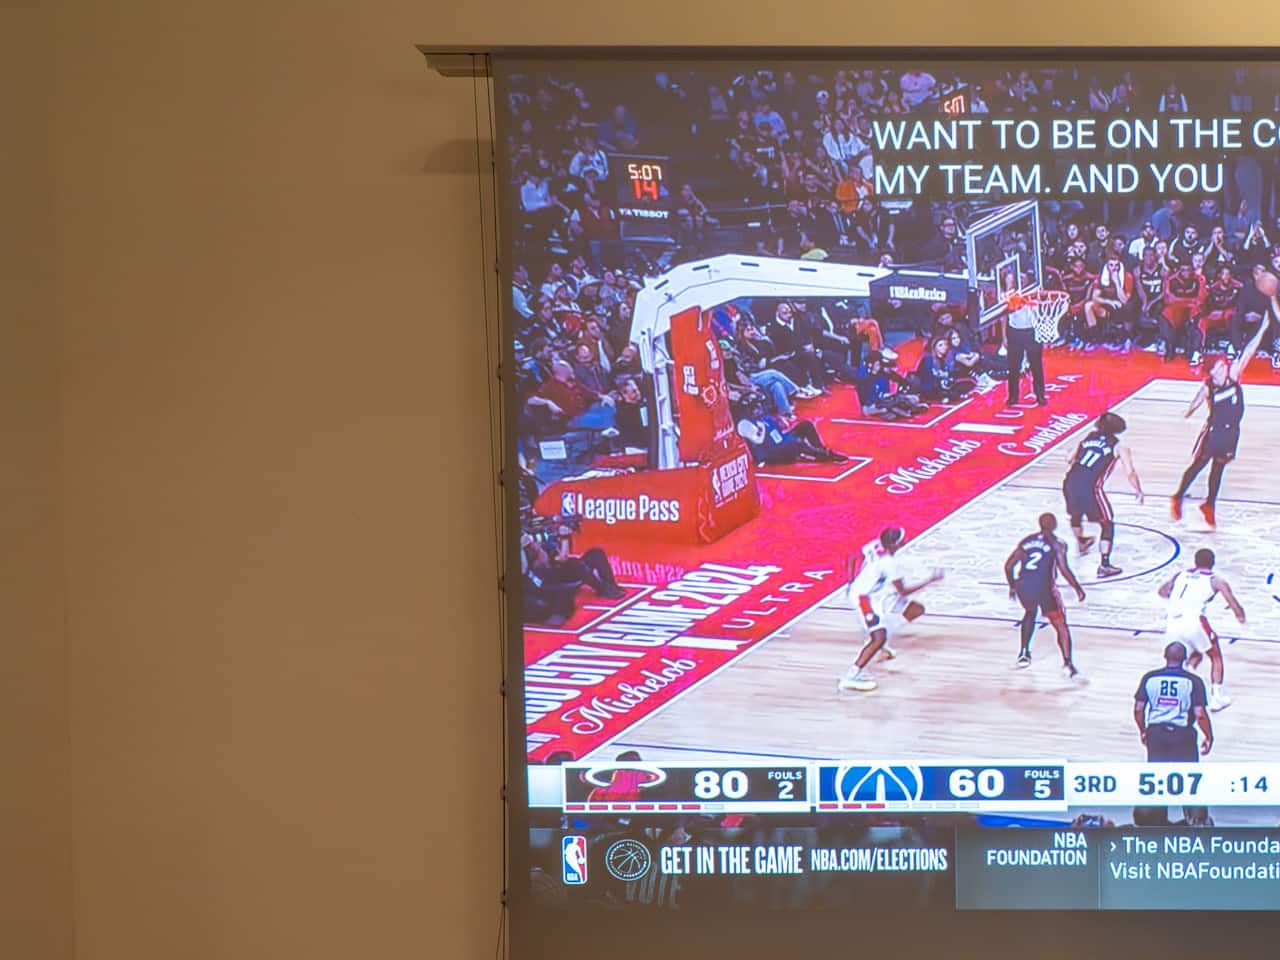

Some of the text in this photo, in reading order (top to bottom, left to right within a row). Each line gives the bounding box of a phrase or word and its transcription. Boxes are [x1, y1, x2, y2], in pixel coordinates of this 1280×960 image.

[873, 120, 982, 150] WANT
[992, 120, 1040, 150] TO
[1052, 120, 1096, 149] BE
[1106, 119, 1158, 149] ON
[1169, 119, 1242, 149] THE
[628, 164, 662, 180] 5:07
[874, 163, 1224, 194] MY TEAM. AND YOU
[634, 180, 659, 200] 14
[639, 494, 680, 521] Pass
[1025, 552, 1042, 570] 2
[721, 569, 833, 629] ULTRA
[561, 657, 697, 736] Michelob
[693, 770, 803, 799] 80 FOULS
[778, 780, 794, 800] 2
[949, 769, 1060, 798] 60 FOULS
[1033, 780, 1051, 799] 5
[1074, 772, 1269, 796] 3RD 5:07 :14
[1054, 832, 1088, 848] NBA
[1123, 837, 1158, 854] The
[1164, 836, 1204, 854] NBA
[660, 846, 691, 874] GET
[698, 846, 715, 874] IN
[719, 846, 749, 874] THE
[754, 845, 803, 874] GAME
[811, 848, 948, 873] NBA.COM/ELECTIONS
[987, 849, 1088, 866] FOUNDATION
[1110, 862, 1152, 880] Visit
